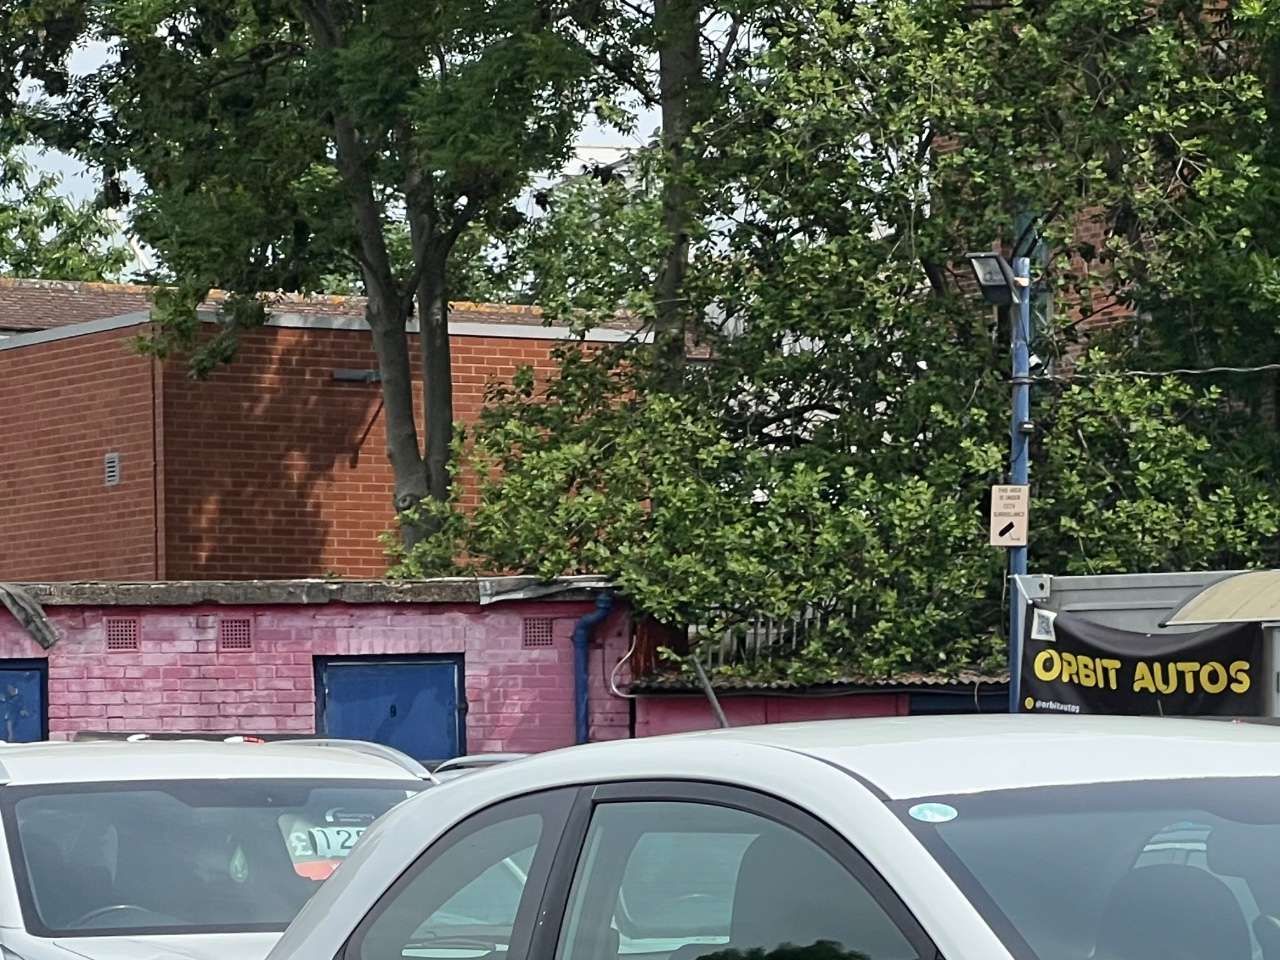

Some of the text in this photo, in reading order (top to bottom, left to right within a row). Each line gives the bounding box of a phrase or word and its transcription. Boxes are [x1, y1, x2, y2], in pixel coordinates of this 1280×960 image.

[1034, 648, 1251, 694] ORBIT AUTOS
[1035, 699, 1080, 713] @orbitautos
